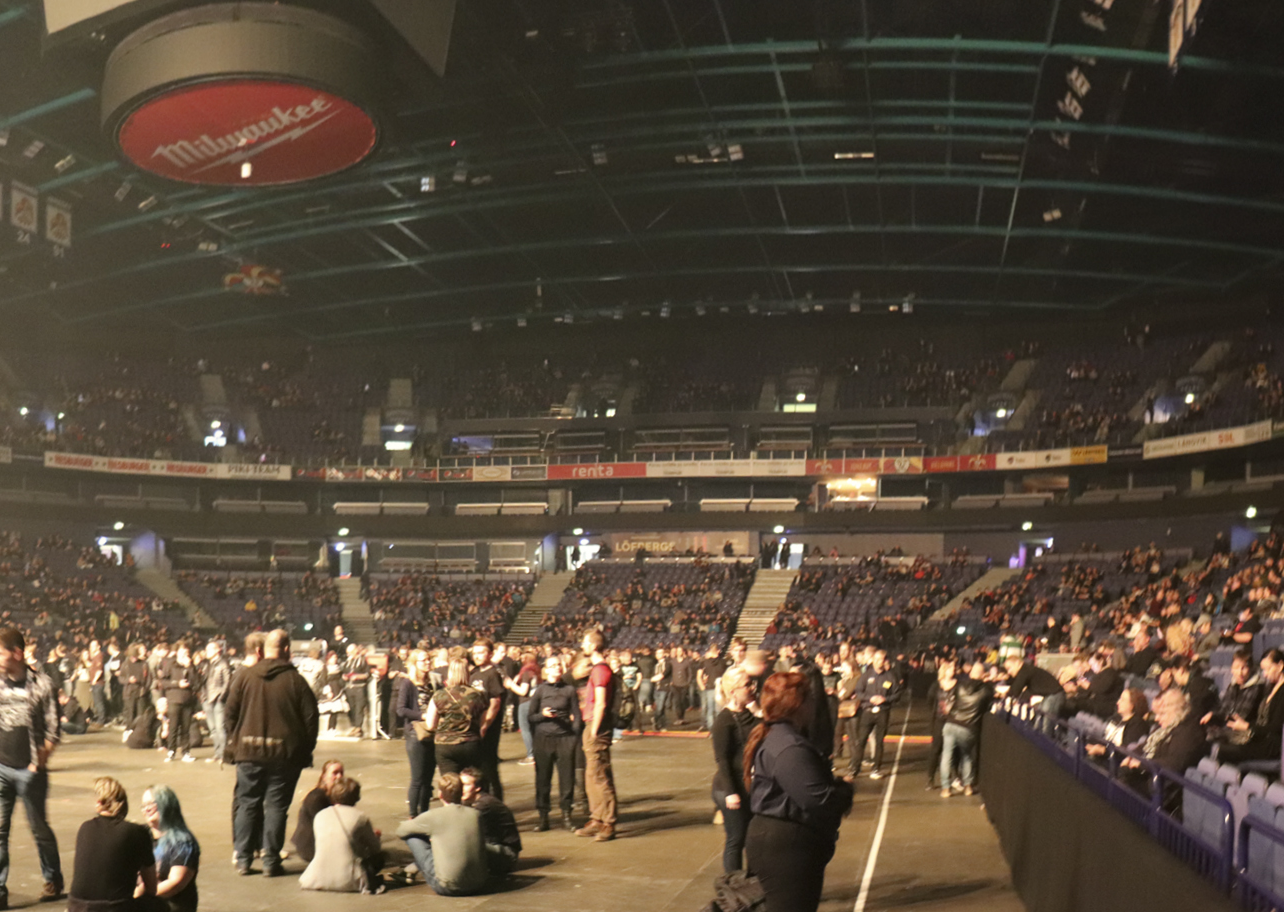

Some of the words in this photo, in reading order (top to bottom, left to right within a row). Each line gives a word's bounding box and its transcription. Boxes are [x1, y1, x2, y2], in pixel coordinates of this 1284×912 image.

[151, 95, 333, 168] Milwaukee
[17, 230, 31, 244] 24
[572, 464, 615, 478] renta
